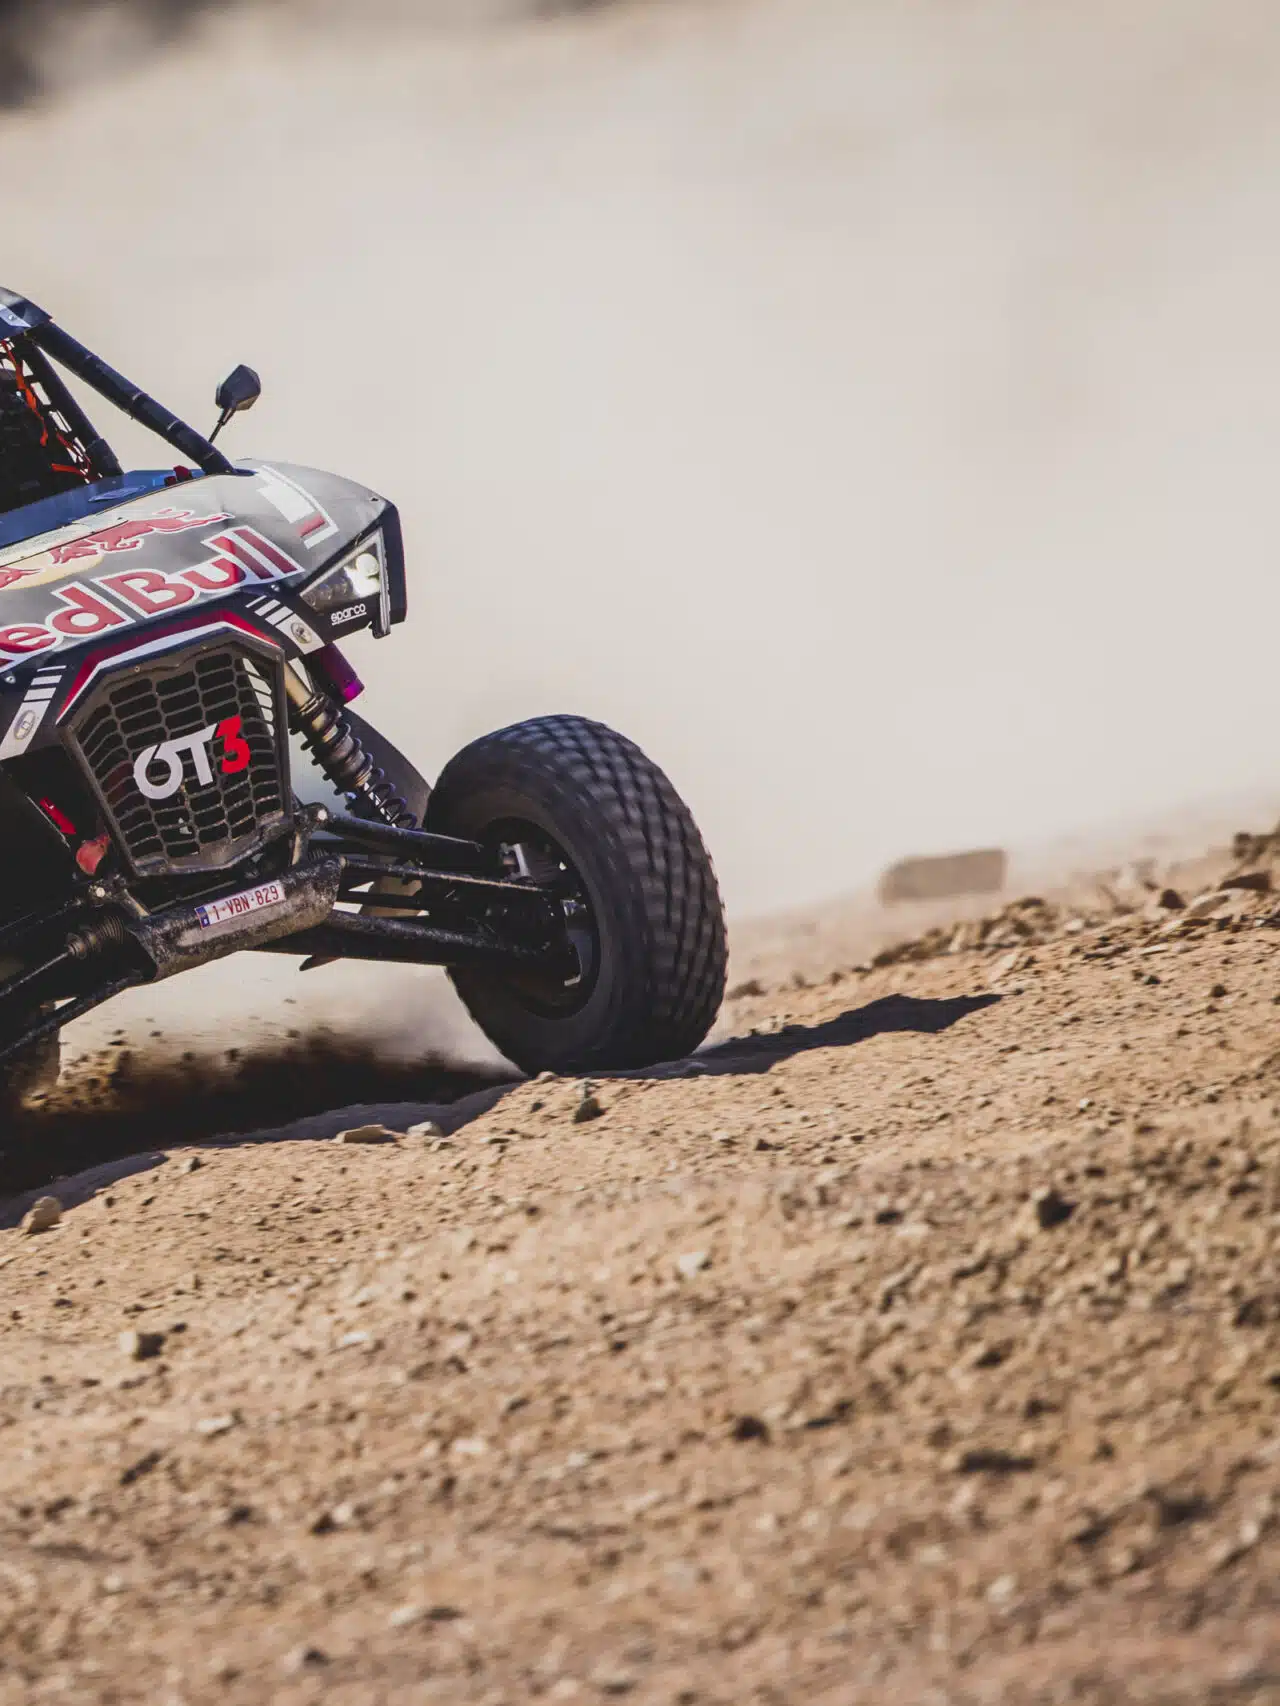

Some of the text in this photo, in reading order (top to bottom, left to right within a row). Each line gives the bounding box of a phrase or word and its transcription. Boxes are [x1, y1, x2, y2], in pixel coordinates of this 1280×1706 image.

[96, 527, 304, 617] Bull
[331, 603, 366, 623] sparco
[212, 884, 280, 921] 1-VBN-829
